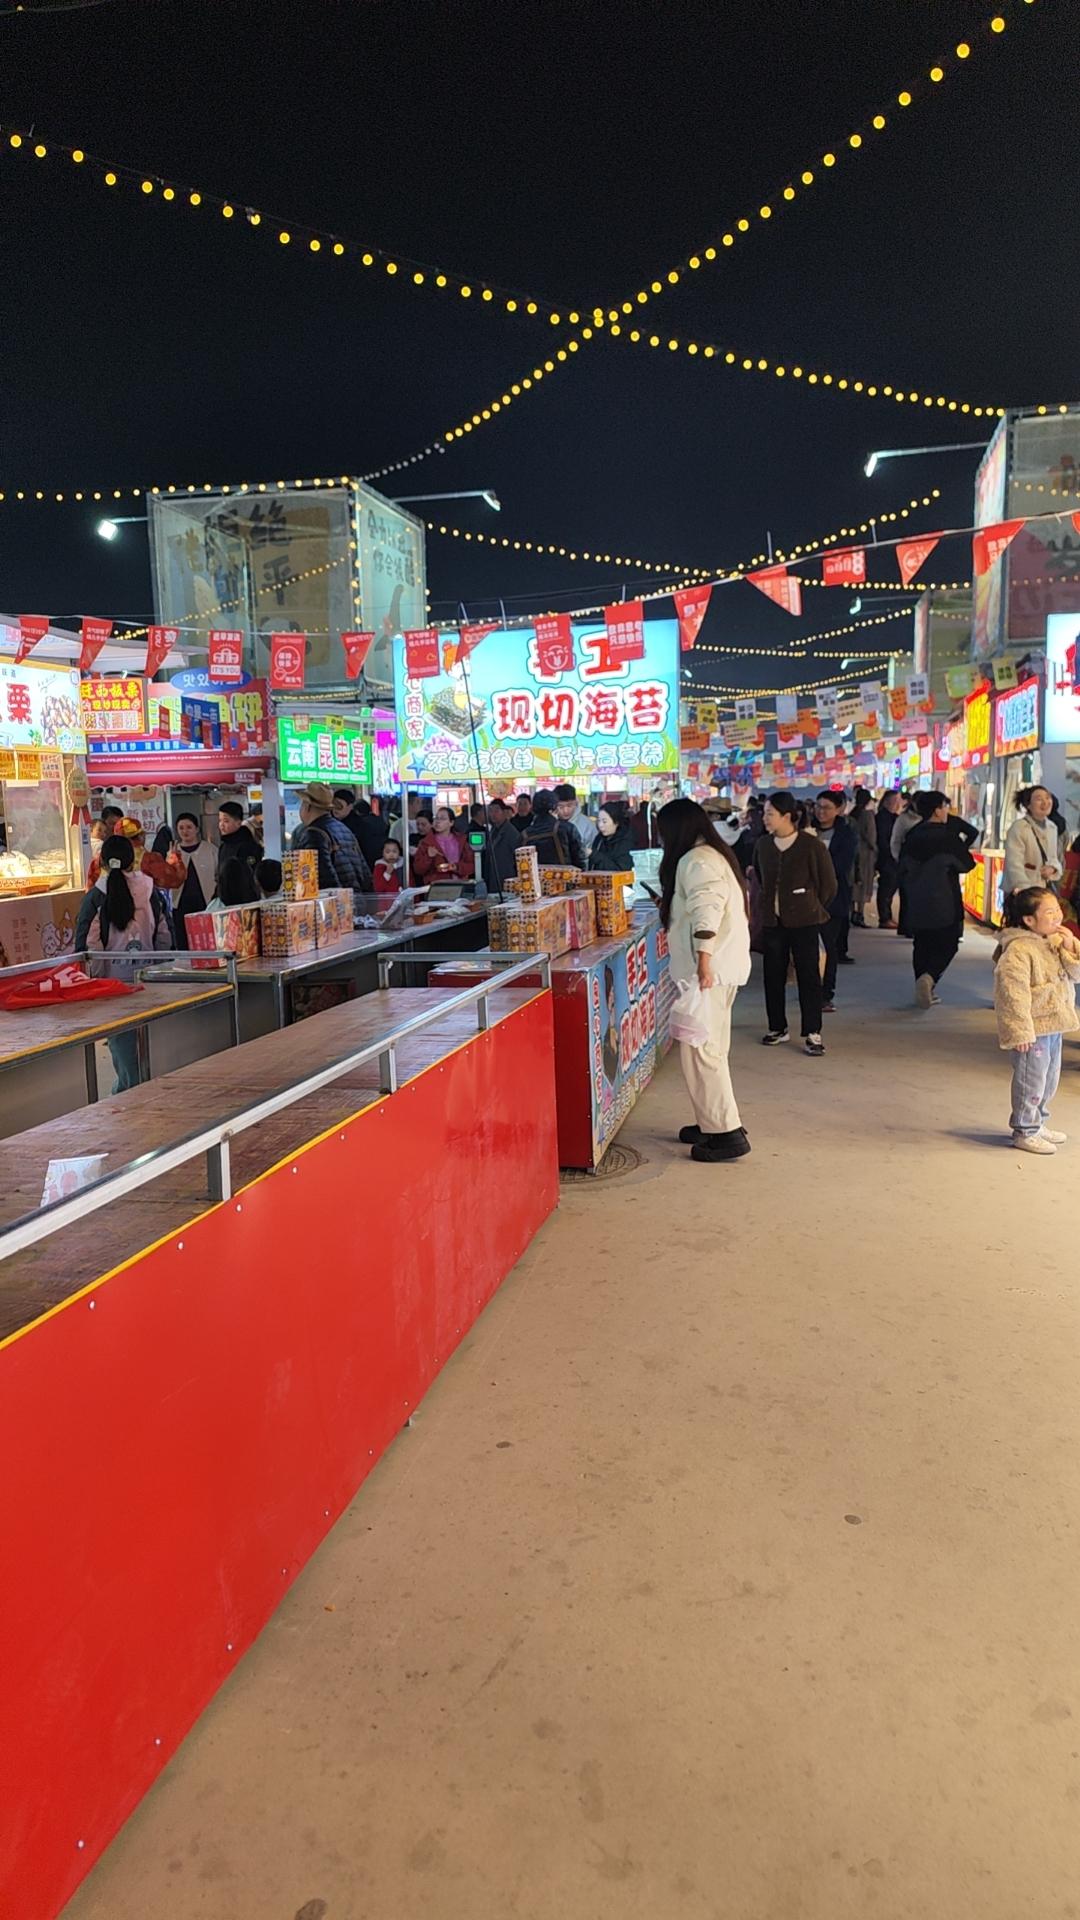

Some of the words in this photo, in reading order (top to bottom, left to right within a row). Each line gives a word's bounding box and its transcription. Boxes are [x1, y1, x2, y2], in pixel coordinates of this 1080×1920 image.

[497, 687, 664, 735] 现切海苔
[287, 734, 367, 772] 云南昆虫宴
[428, 748, 533, 773] 不好吃免单
[552, 741, 664, 769] 低卡高营养
